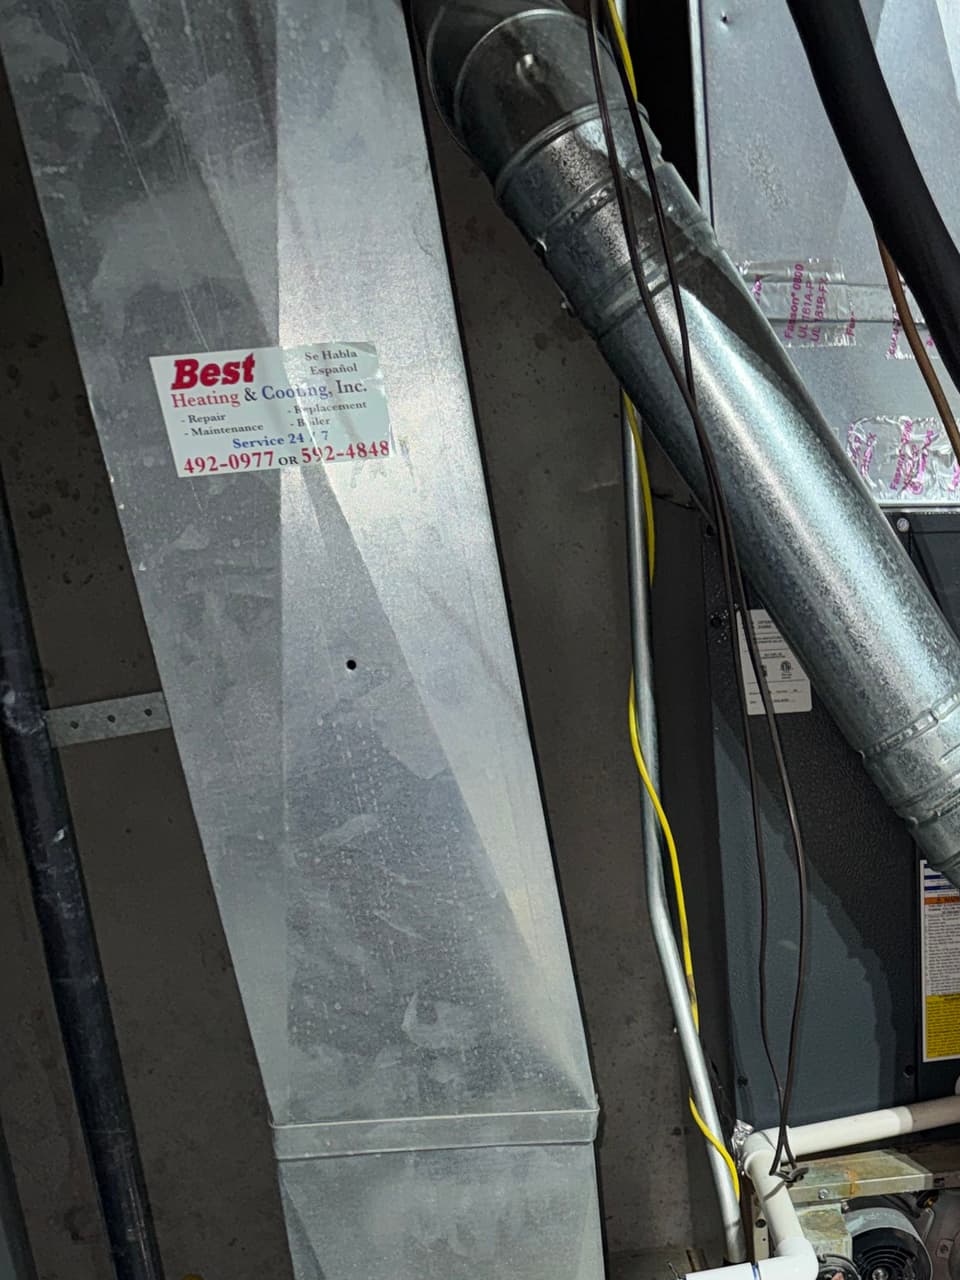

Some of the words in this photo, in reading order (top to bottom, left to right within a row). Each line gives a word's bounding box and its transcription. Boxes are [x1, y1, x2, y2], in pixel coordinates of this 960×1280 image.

[305, 352, 319, 361] Se
[322, 349, 358, 360] Habla
[170, 353, 256, 391] Best
[310, 363, 358, 376] Español
[170, 392, 240, 409] Heating
[244, 388, 257, 402] &
[336, 380, 367, 394] Inc.
[188, 413, 226, 425] Repair
[297, 418, 330, 428] Biler
[191, 424, 264, 437] Maintenance
[233, 437, 284, 449] Service
[288, 433, 304, 444] 24
[321, 430, 329, 441] 7
[183, 451, 274, 474] 492-0977
[278, 456, 298, 466] OR
[301, 440, 390, 464] 592-4848
